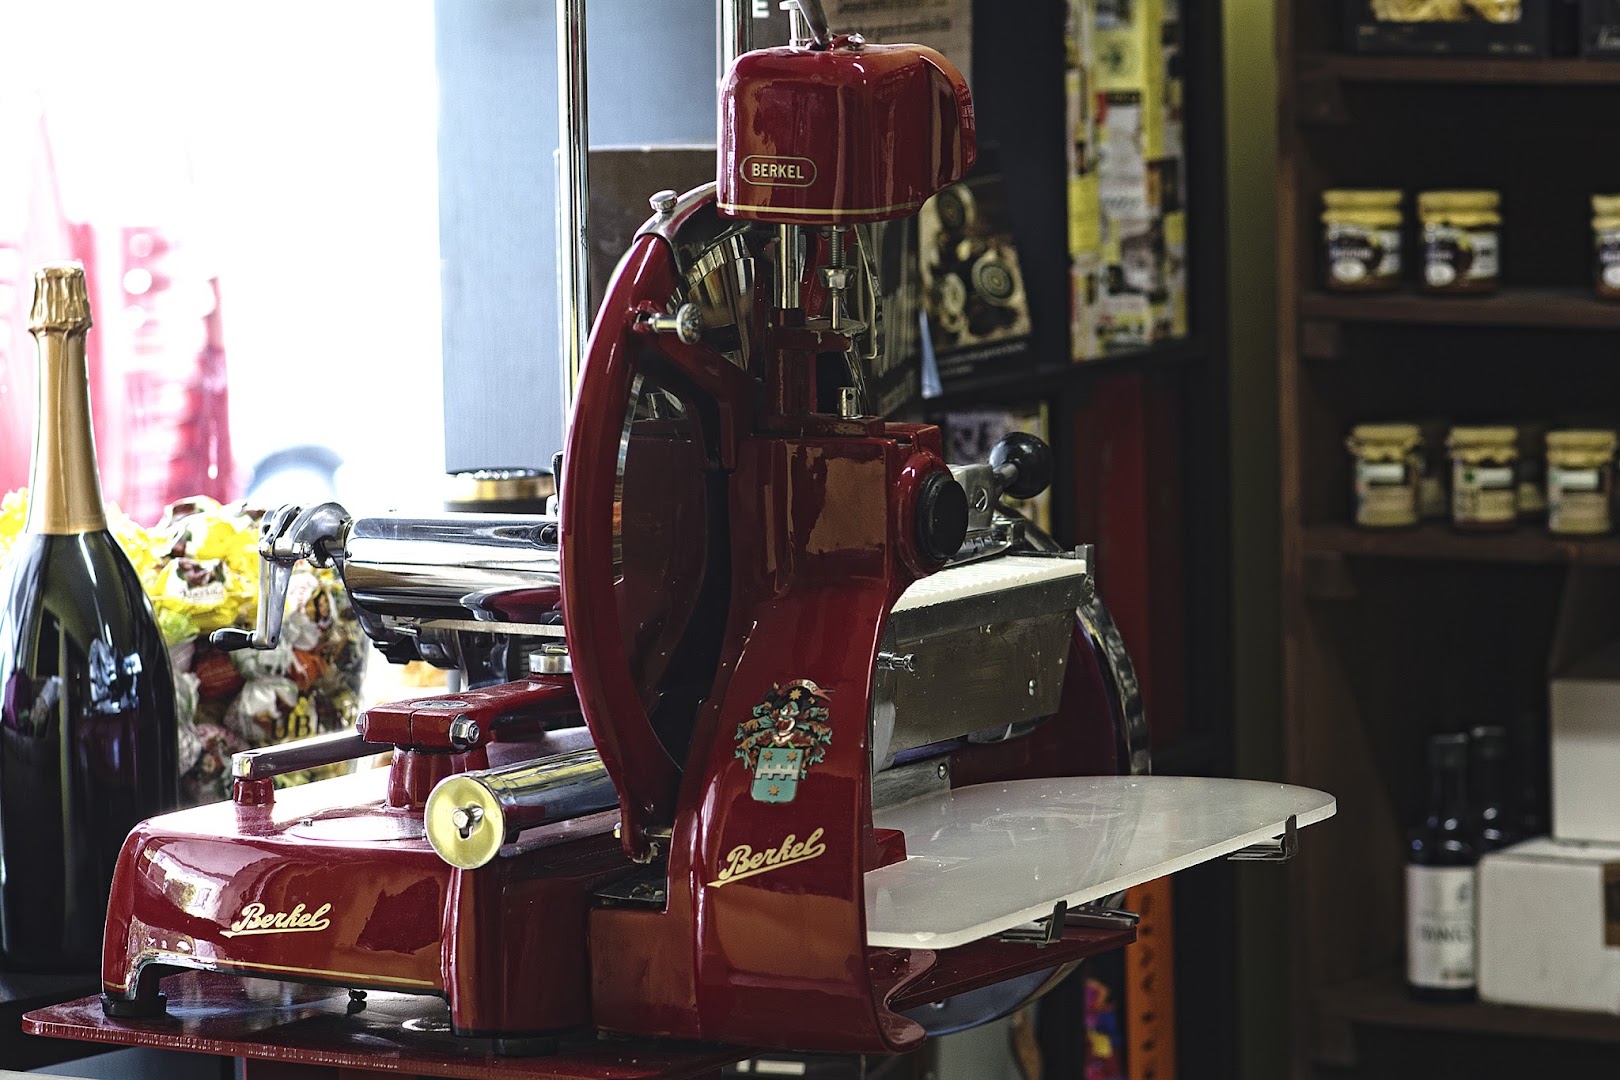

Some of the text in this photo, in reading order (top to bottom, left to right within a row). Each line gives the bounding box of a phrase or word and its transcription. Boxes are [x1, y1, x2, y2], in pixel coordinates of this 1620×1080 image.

[752, 163, 805, 179] BERKEL
[707, 827, 826, 888] Berkel
[219, 902, 331, 938] Berkel
